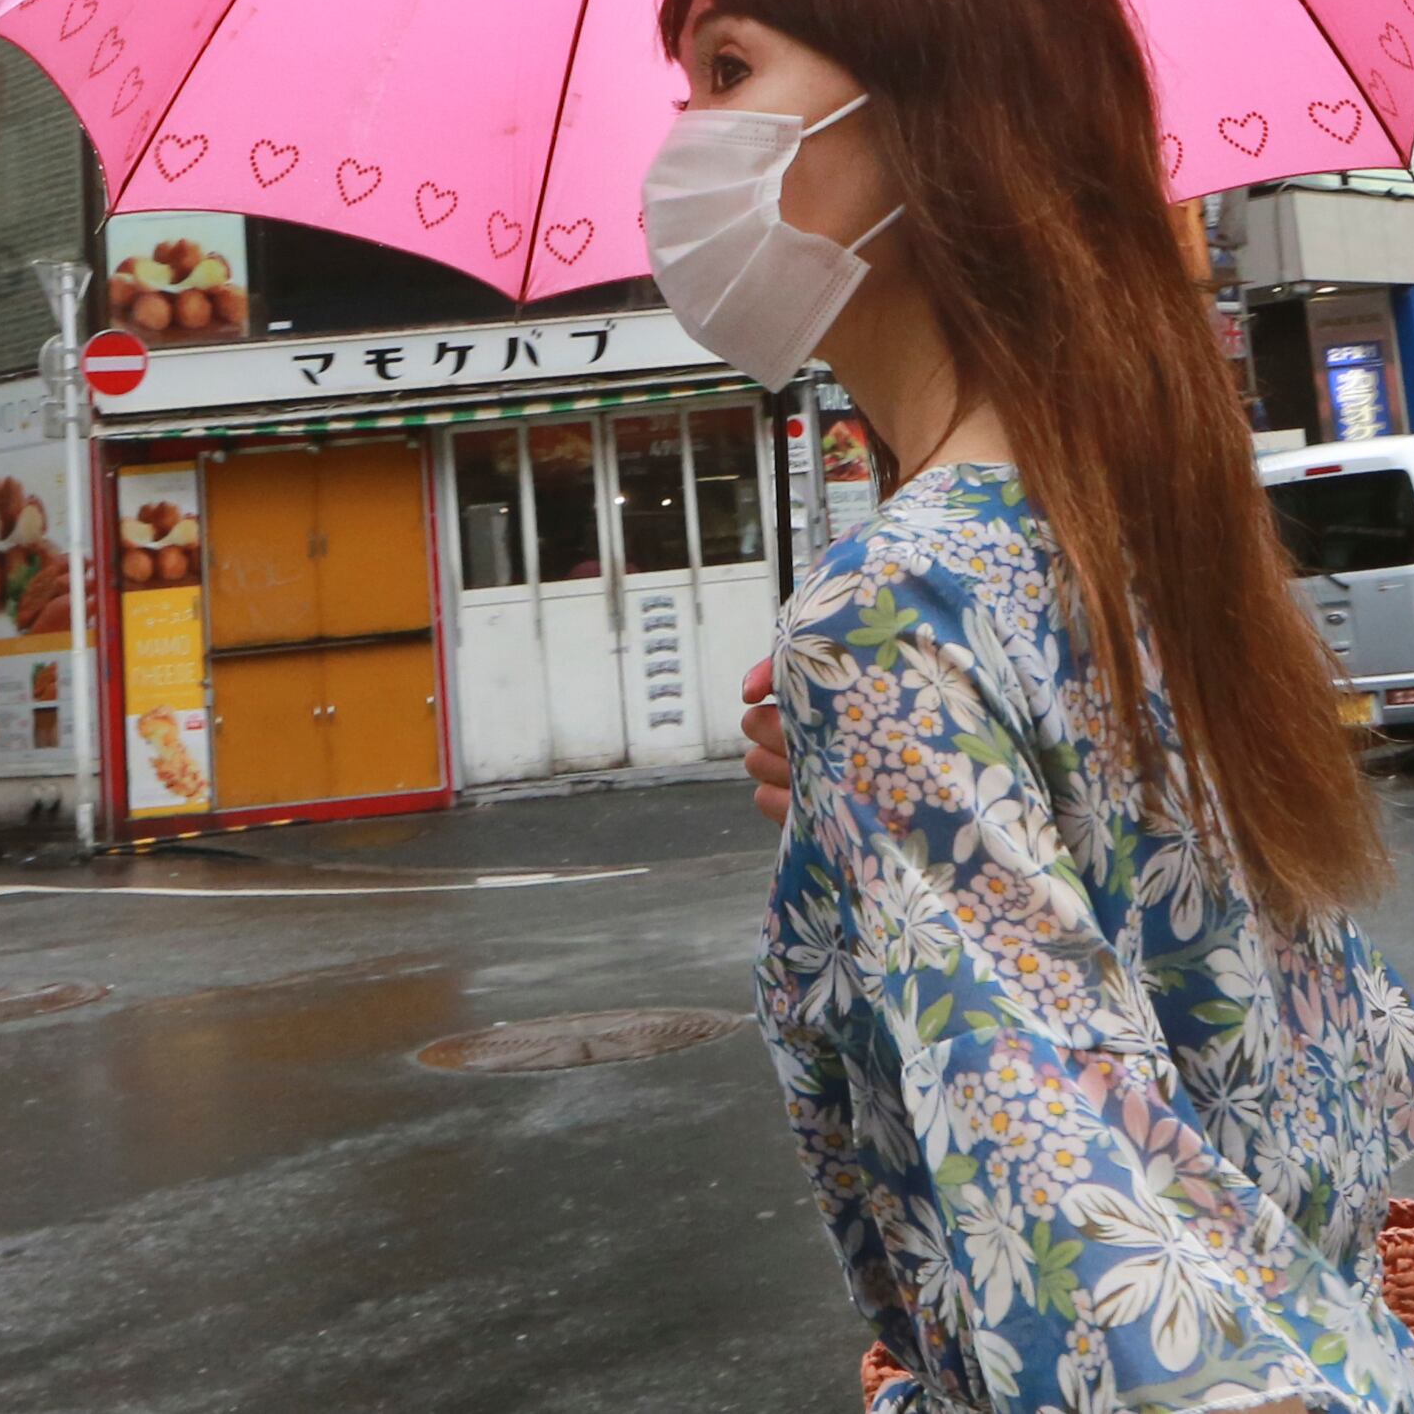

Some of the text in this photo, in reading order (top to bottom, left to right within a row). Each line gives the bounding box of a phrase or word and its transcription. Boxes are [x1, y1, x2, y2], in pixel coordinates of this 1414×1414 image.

[291, 318, 618, 386] マモケバブ
